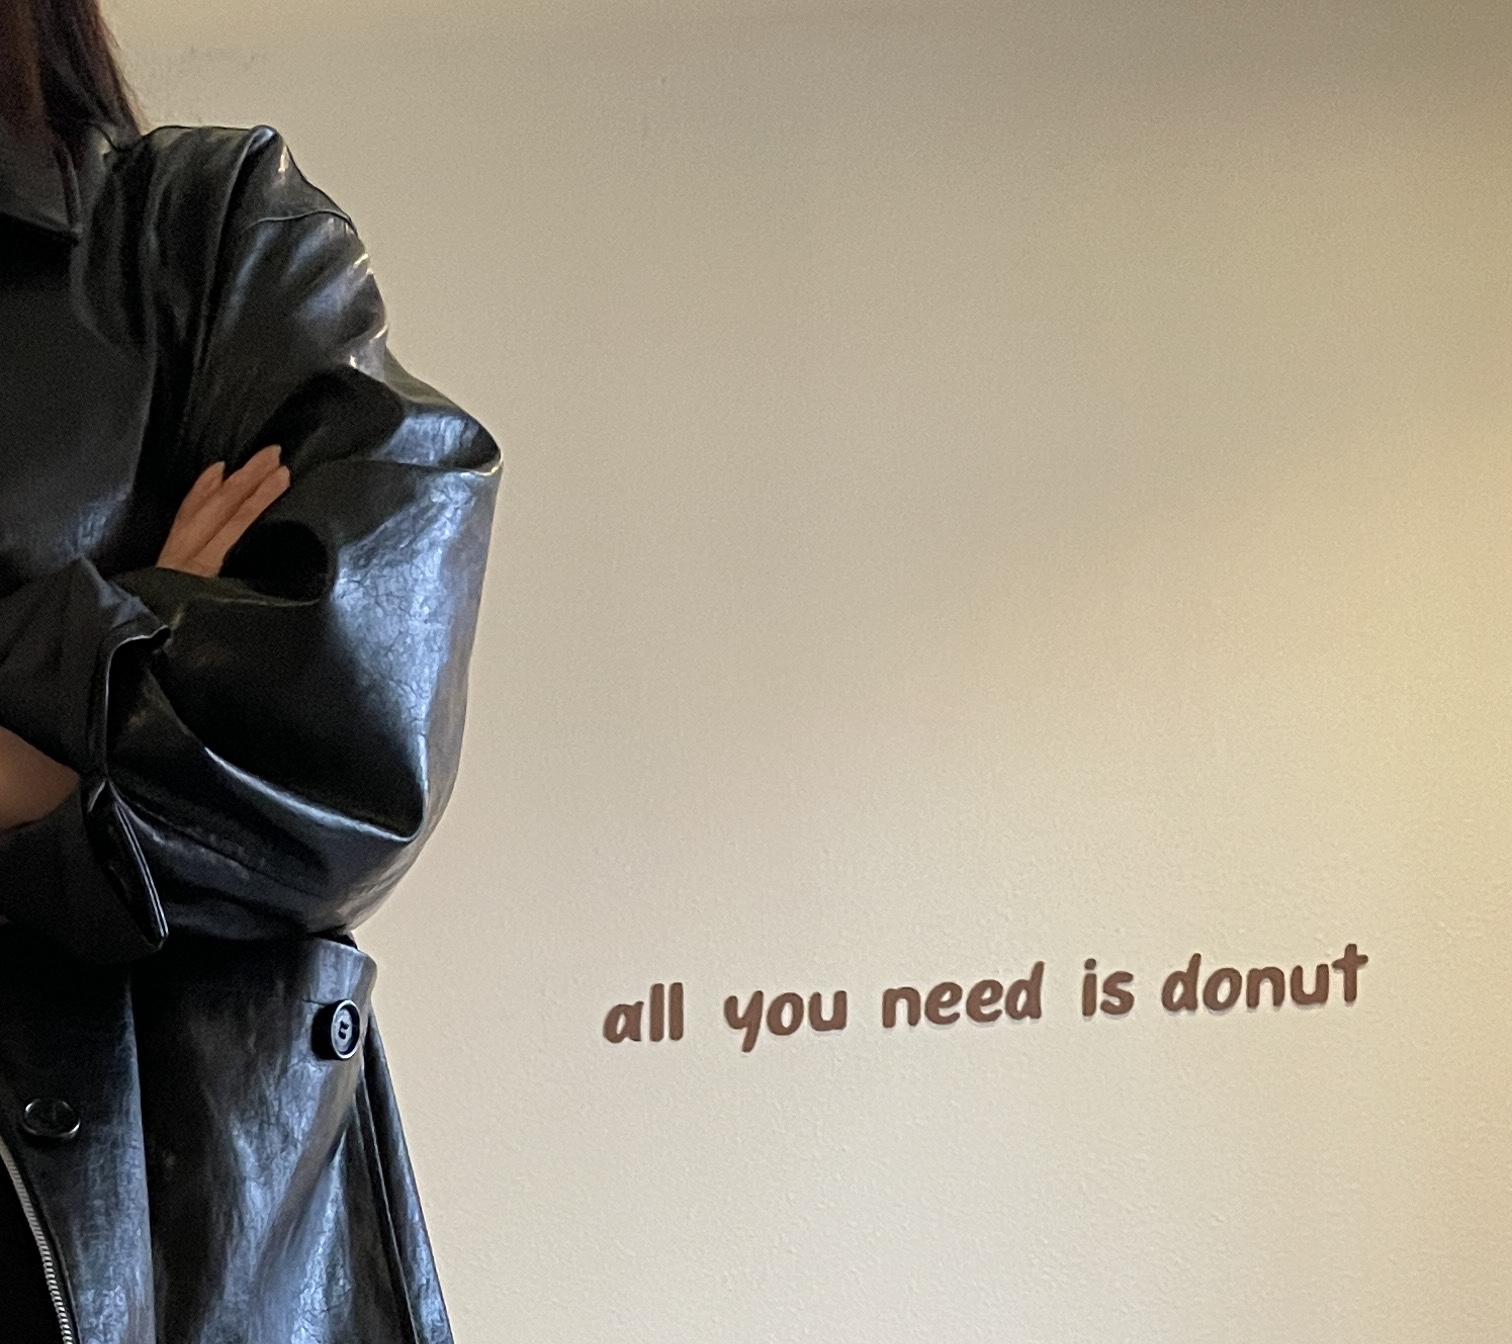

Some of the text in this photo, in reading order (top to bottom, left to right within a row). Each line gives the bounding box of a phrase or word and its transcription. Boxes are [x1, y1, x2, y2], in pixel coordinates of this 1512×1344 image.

[602, 943, 1369, 1054] all you need is donut
